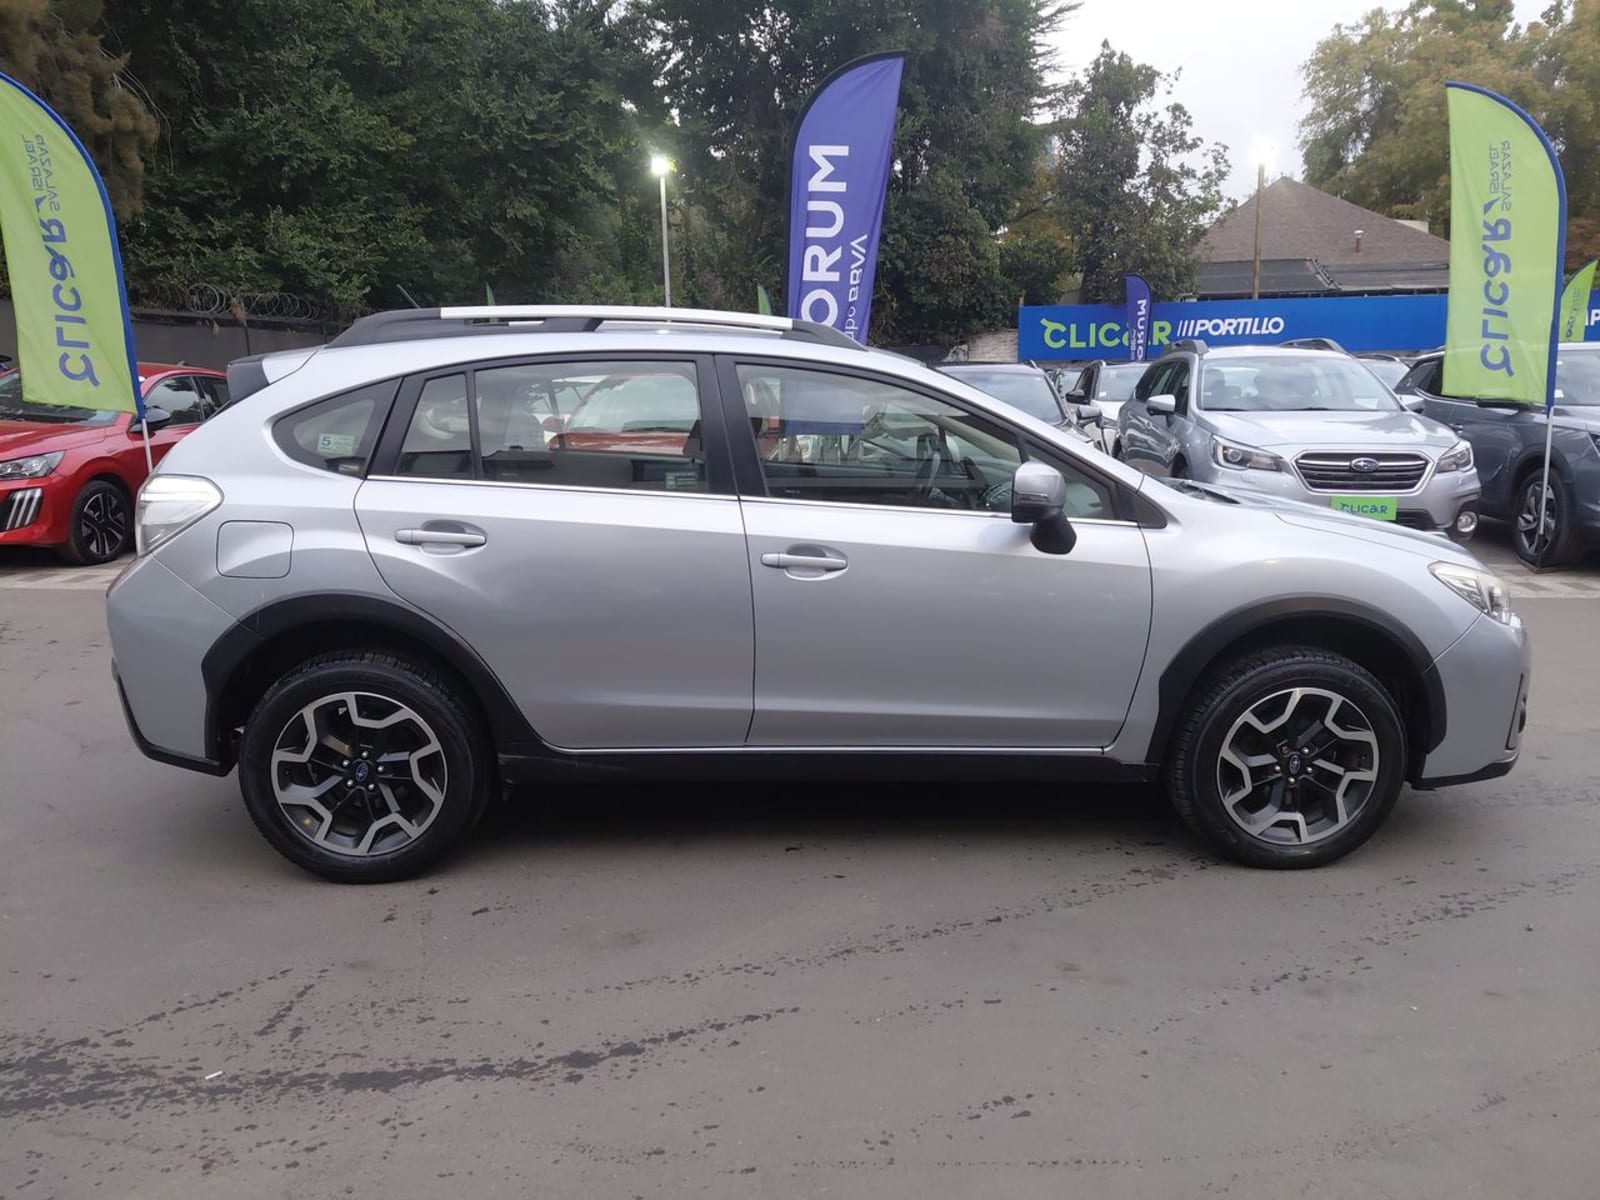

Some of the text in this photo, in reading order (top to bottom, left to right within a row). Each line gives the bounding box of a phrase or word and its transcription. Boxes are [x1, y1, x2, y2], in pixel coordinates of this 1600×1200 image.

[801, 145, 849, 328] ORUM
[848, 234, 868, 302] BBVA
[1040, 318, 1172, 348] CLICR
